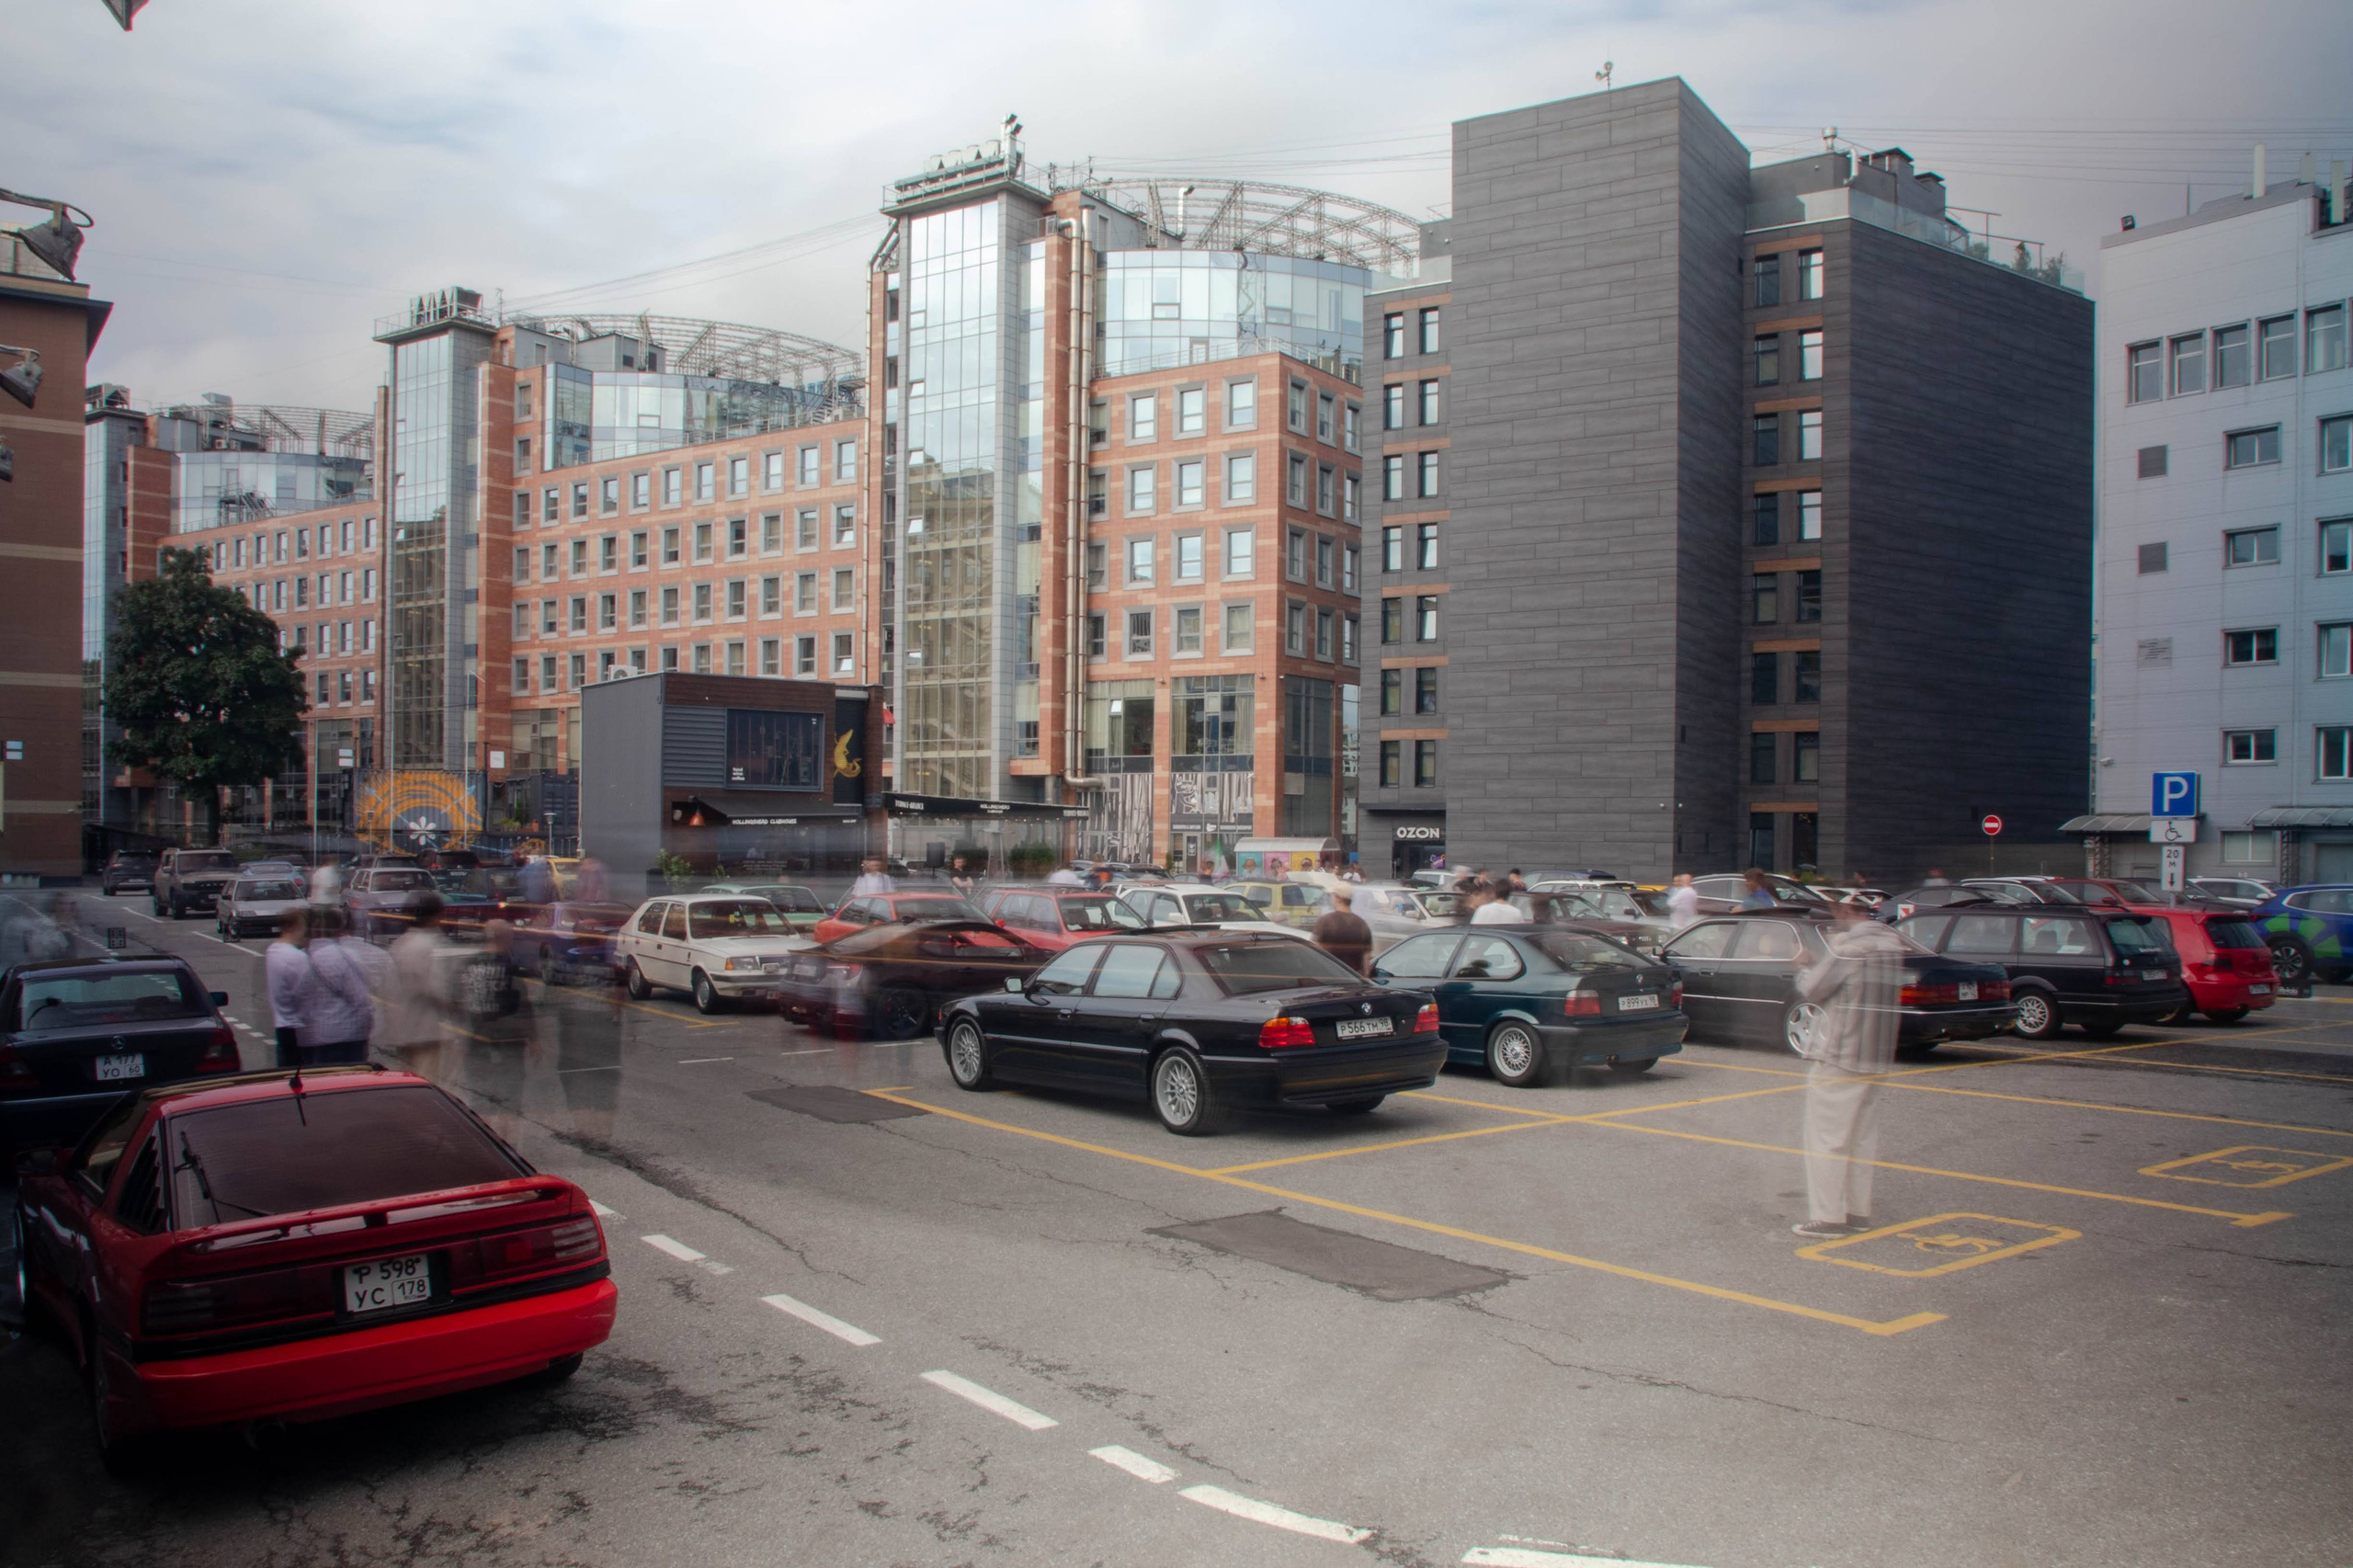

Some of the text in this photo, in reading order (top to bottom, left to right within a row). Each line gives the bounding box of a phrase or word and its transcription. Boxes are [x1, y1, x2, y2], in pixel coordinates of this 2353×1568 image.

[2163, 776, 2189, 812] P
[1396, 827, 1441, 839] OZON
[2166, 849, 2180, 858] 20
[129, 1065, 141, 1074] 60
[379, 1258, 416, 1280] 598
[398, 1278, 426, 1296] 178
